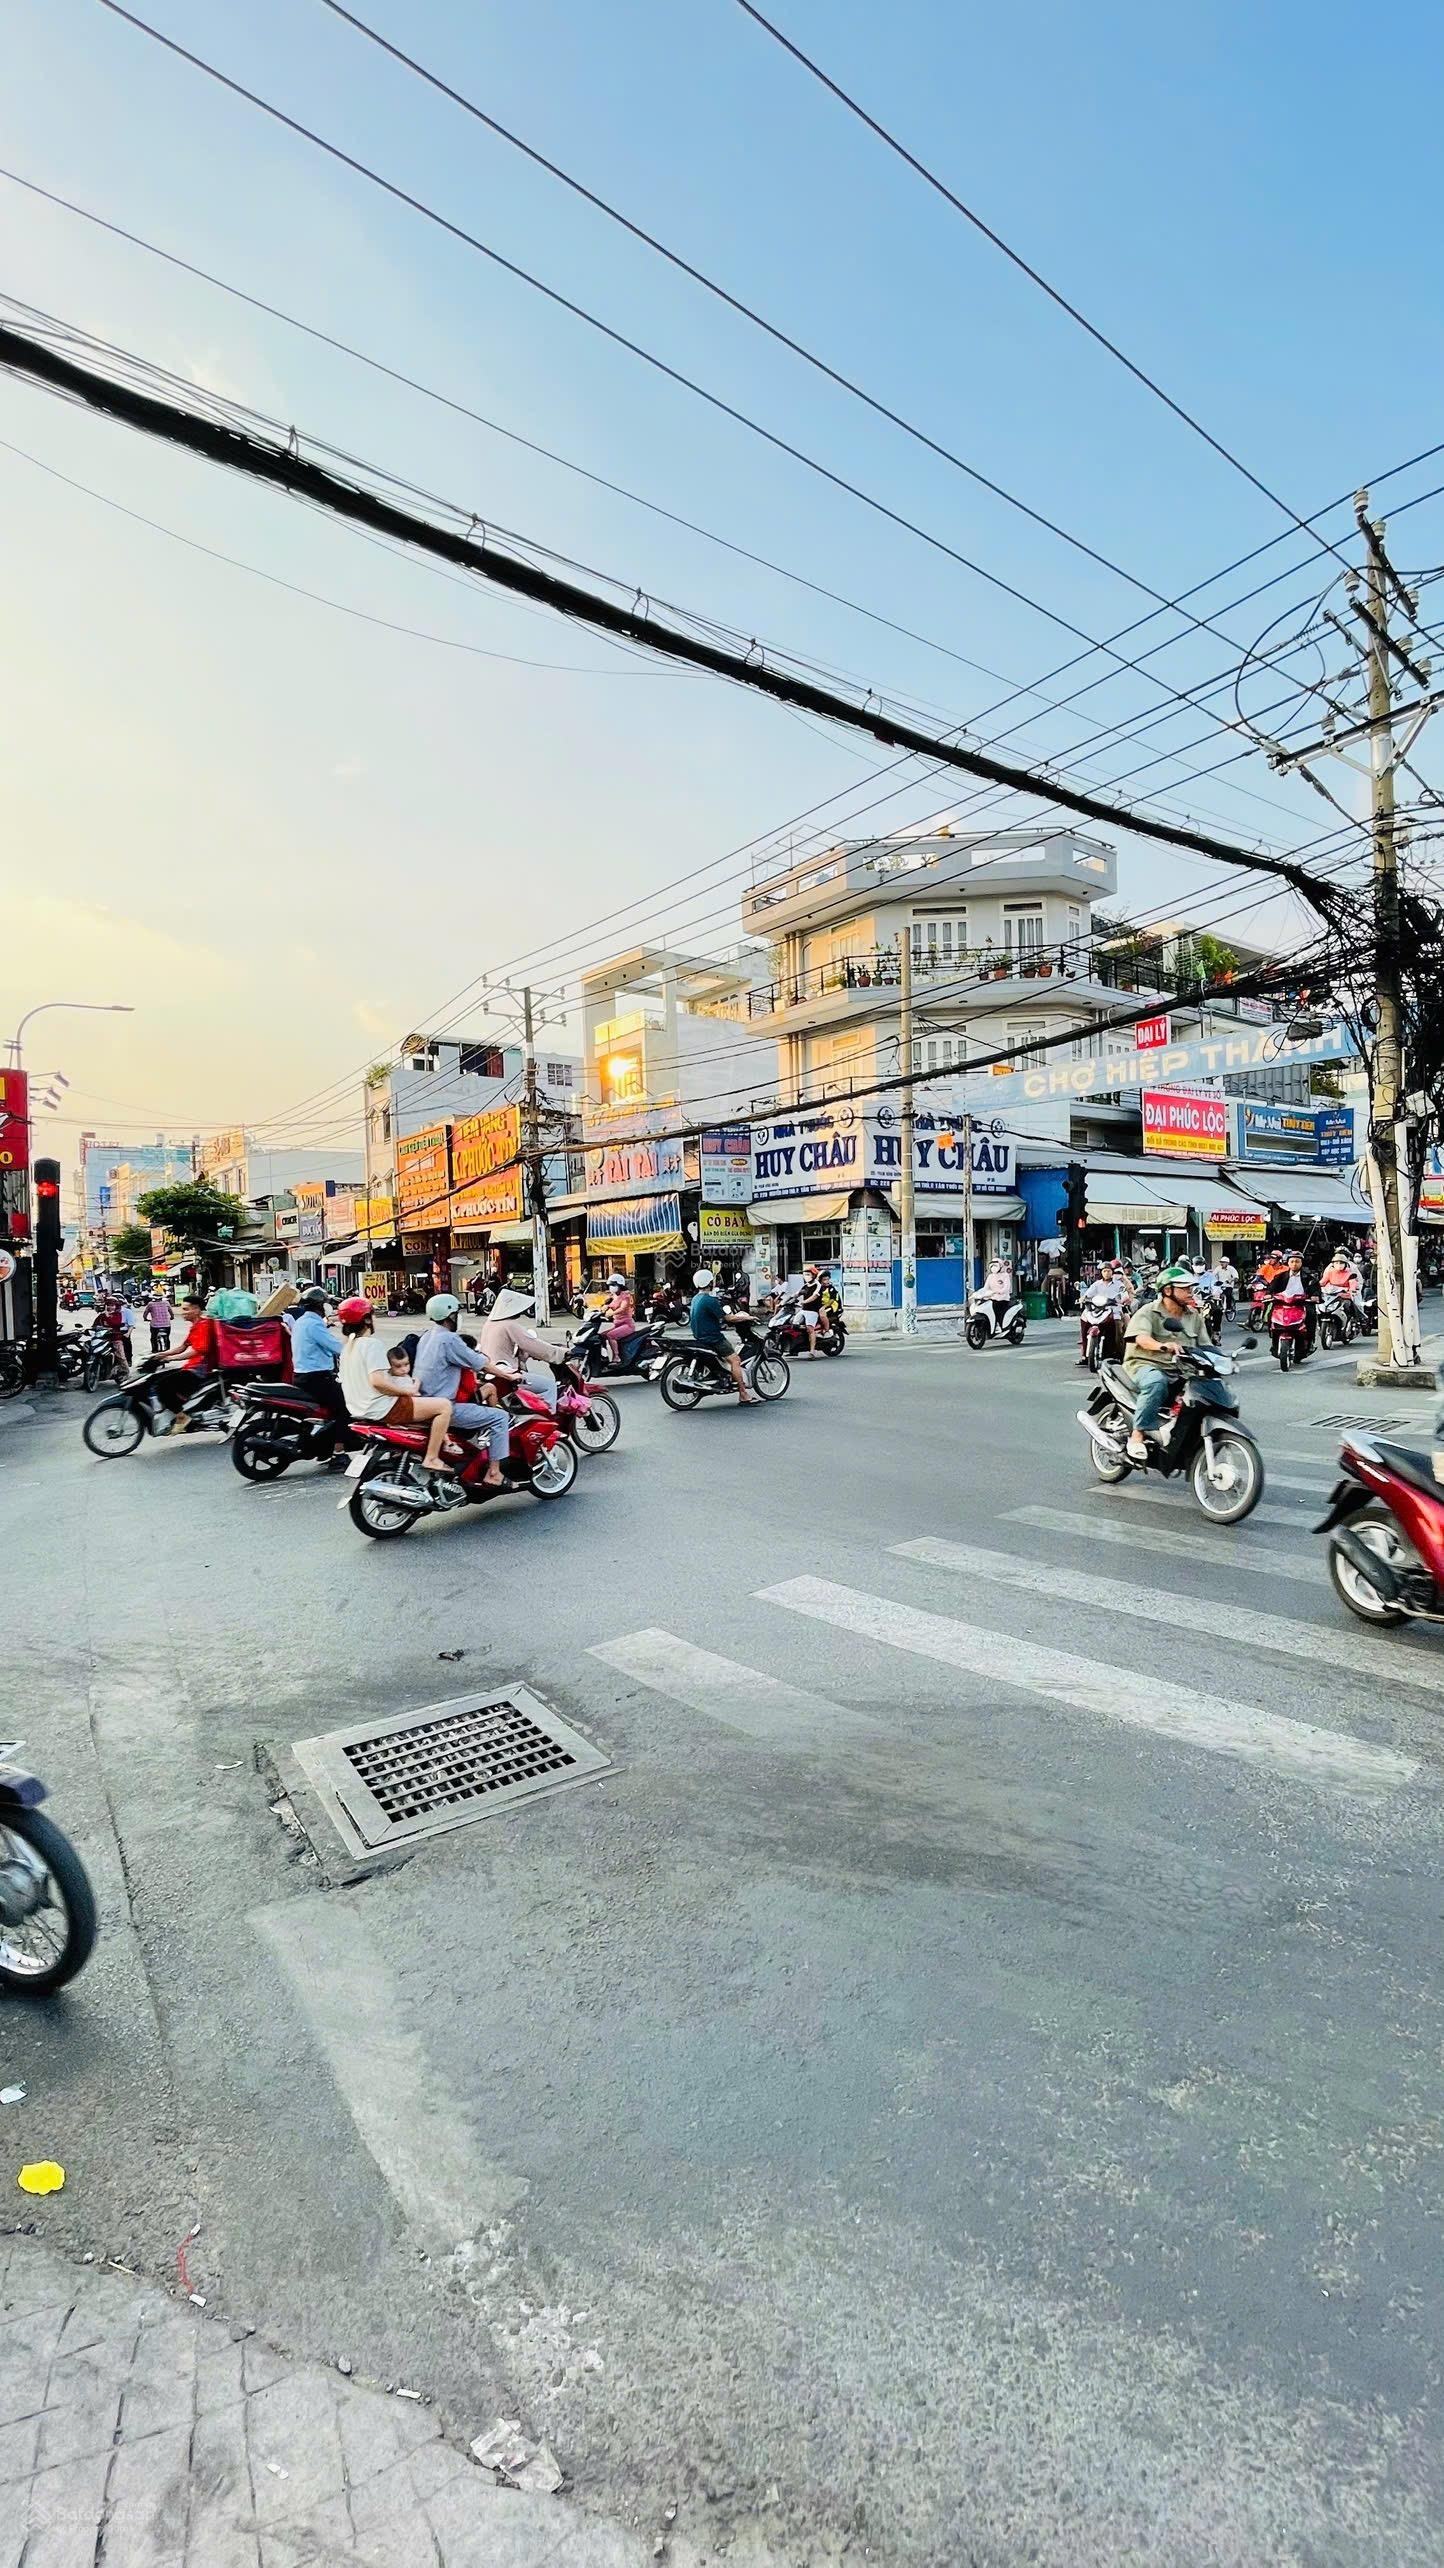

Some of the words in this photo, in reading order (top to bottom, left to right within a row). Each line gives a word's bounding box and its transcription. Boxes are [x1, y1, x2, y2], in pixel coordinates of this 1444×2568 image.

[1137, 1029, 1153, 1048] ĐẠI
[1155, 1022, 1166, 1041] LÝ
[1024, 1060, 1095, 1098] CHỢ
[1107, 1048, 1190, 1087] HIỆP
[1146, 1103, 1167, 1132] ĐẠI
[1169, 1102, 1200, 1130] PHÚC
[1203, 1106, 1224, 1138] LỘC
[755, 1147, 796, 1179] HUY
[800, 1132, 857, 1173] CHÂU
[725, 1211, 746, 1227] BẢY
